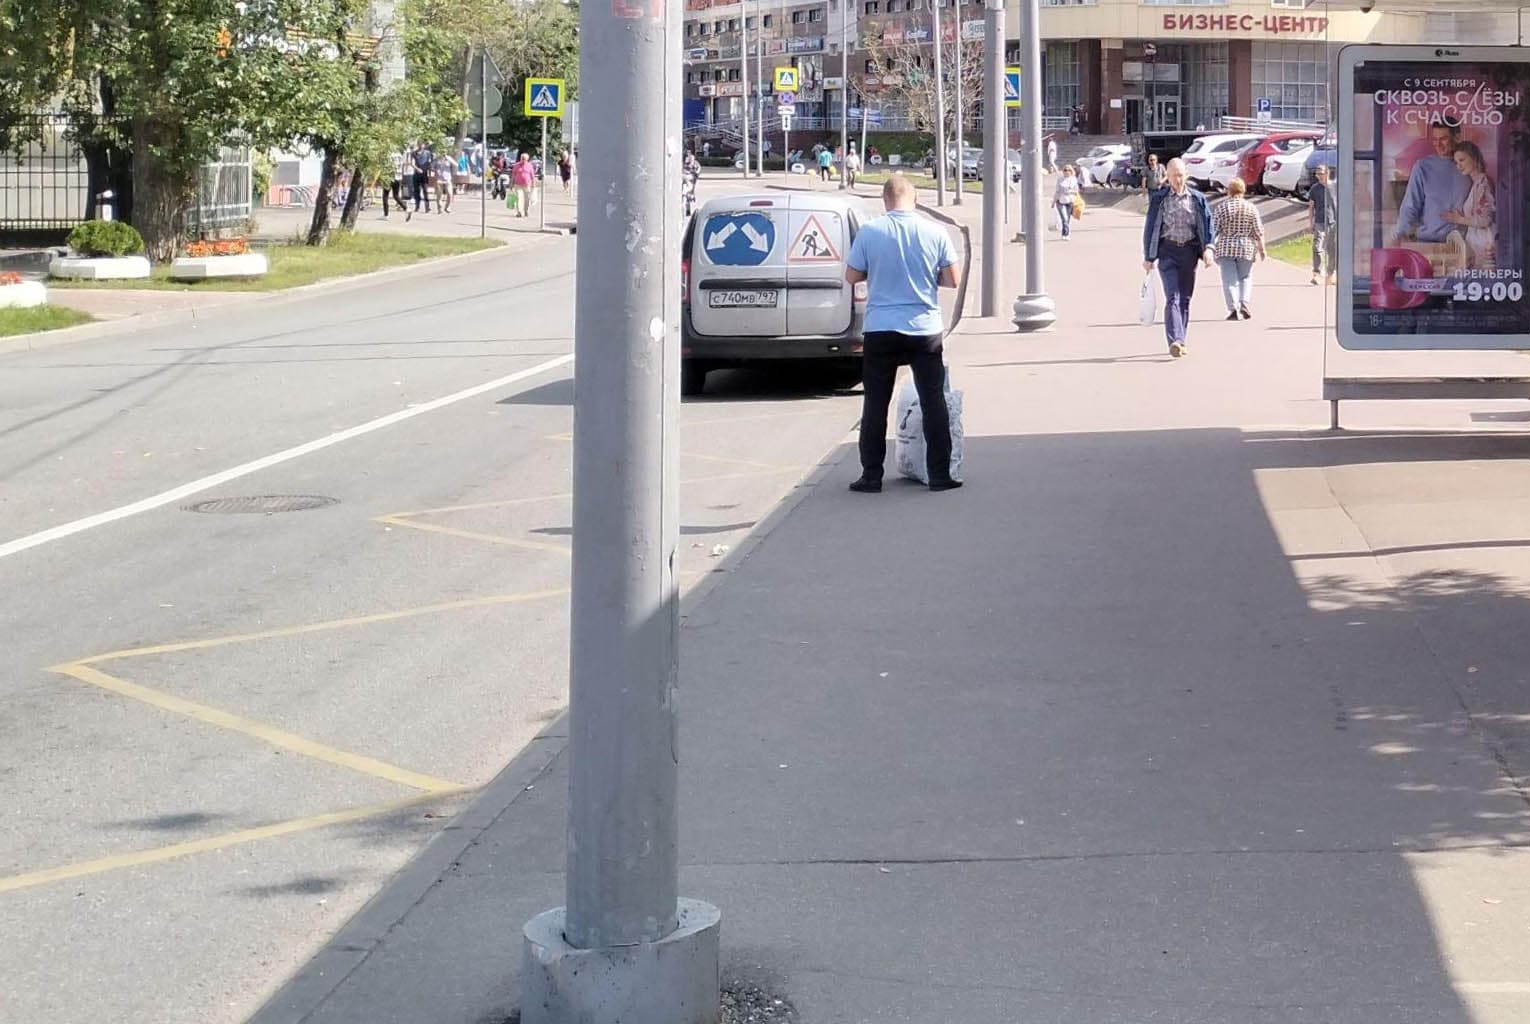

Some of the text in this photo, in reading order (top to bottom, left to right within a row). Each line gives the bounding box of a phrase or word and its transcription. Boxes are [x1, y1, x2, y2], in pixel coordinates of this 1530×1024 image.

[1162, 13, 1330, 34] БИЗНЕС-ЦЕНТР
[1403, 78, 1477, 88] С 9 СЕНТЯБРЯ
[1374, 81, 1520, 113] СКВОЗЬ СЛЁЗЫ
[1386, 104, 1504, 128] К СЧАСТЬЮ
[1454, 268, 1523, 279] ПРЕМЬЕРЫ
[1452, 281, 1523, 302] 19:00
